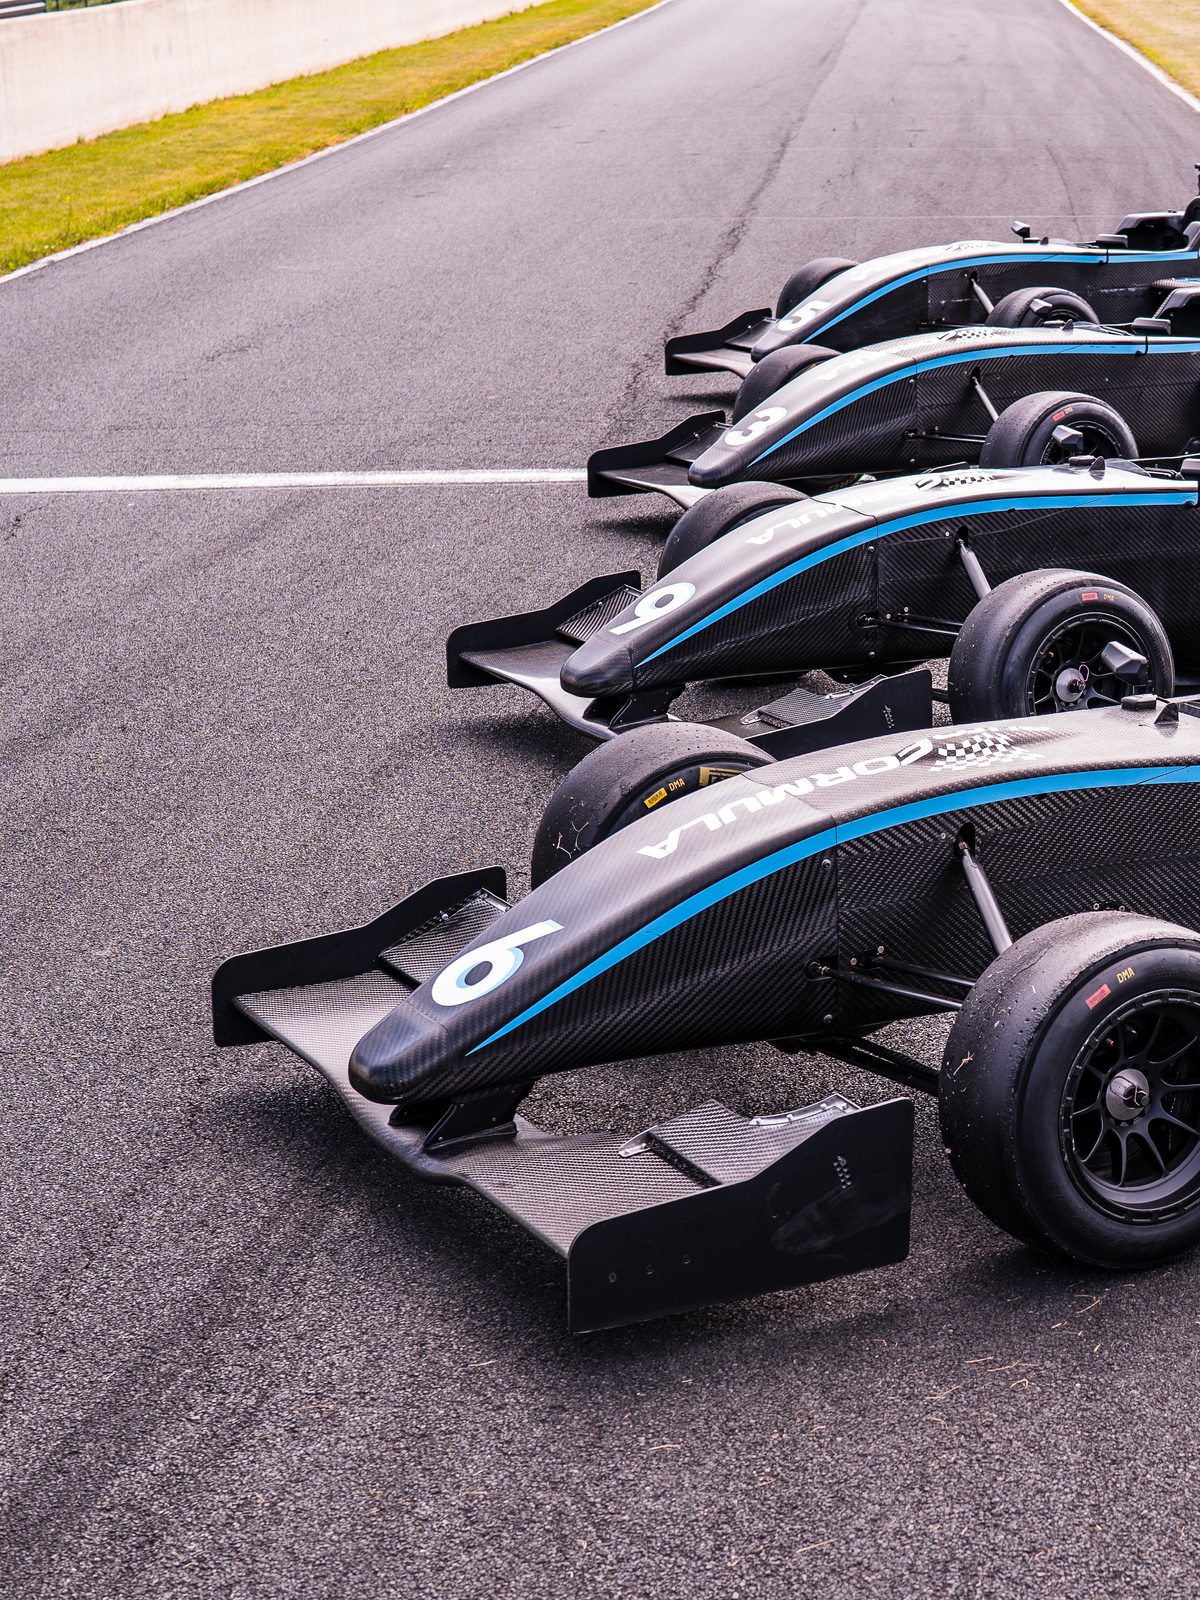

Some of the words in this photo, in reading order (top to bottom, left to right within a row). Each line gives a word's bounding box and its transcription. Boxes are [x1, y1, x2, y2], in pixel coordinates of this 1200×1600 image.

[778, 300, 833, 331] 5
[725, 406, 788, 446] 3
[608, 582, 696, 636] 9
[668, 778, 686, 792] DMA
[431, 919, 566, 1007] 6
[1116, 967, 1135, 984] DMA
